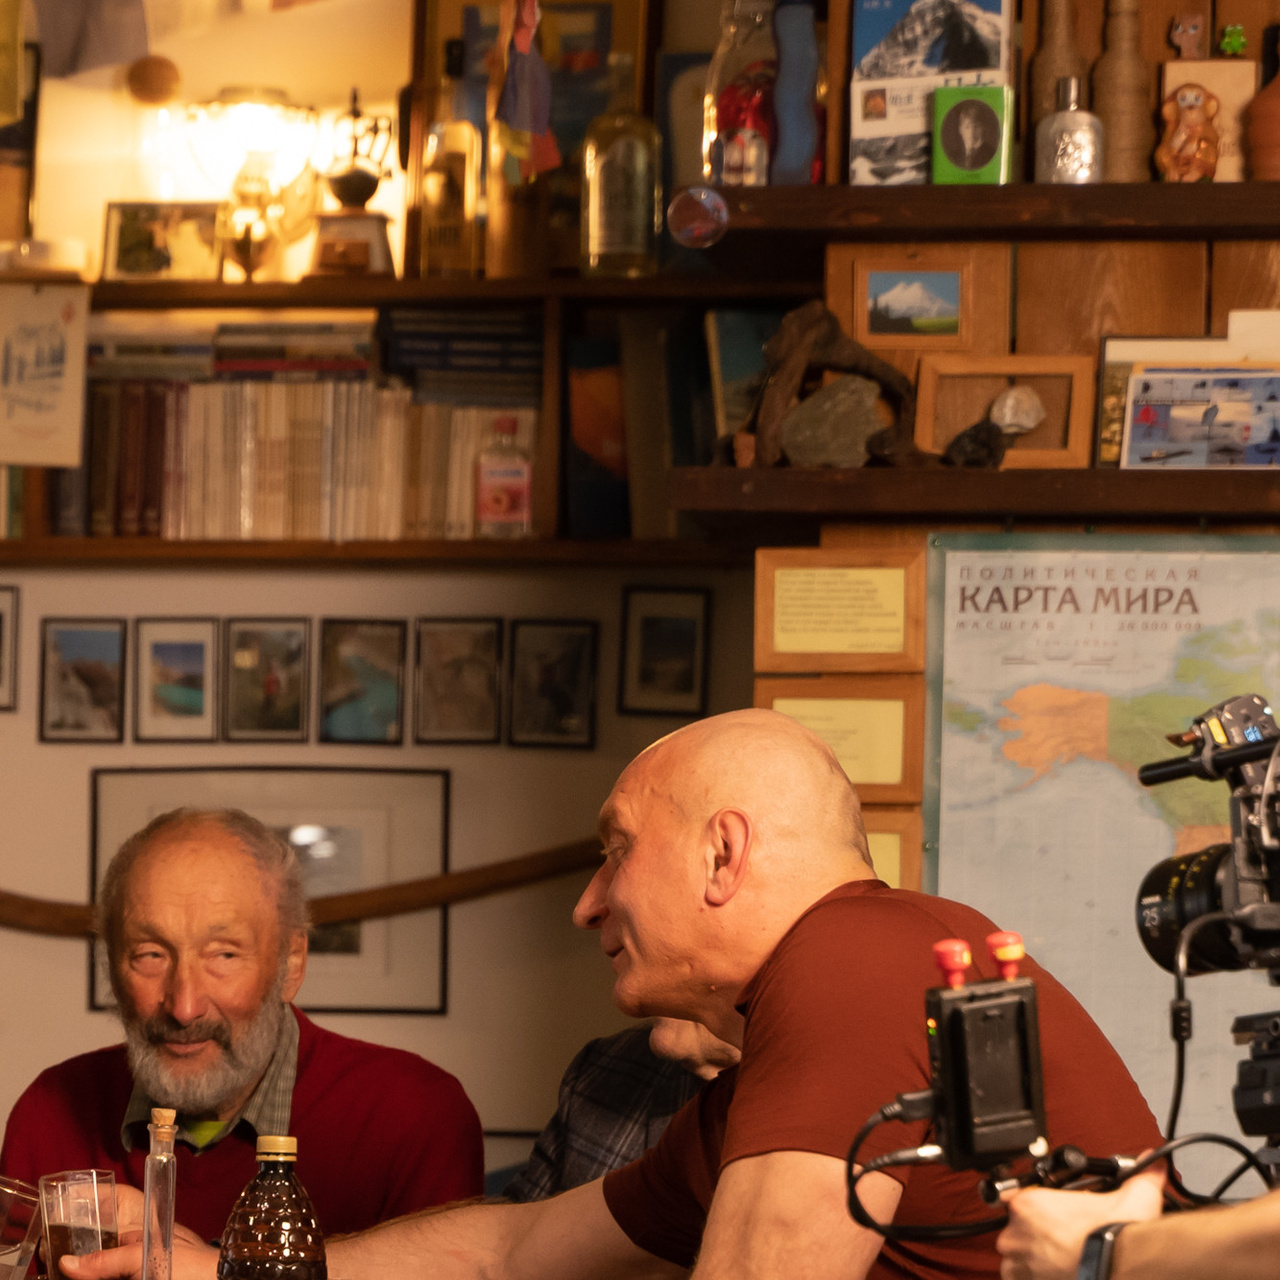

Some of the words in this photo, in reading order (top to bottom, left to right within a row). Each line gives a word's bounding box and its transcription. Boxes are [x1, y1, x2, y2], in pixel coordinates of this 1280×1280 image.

[959, 566, 1201, 581] ПОЛИТИЧЕСКАЯ
[958, 585, 1081, 615] КАРТА
[1091, 586, 1200, 615] МИРА
